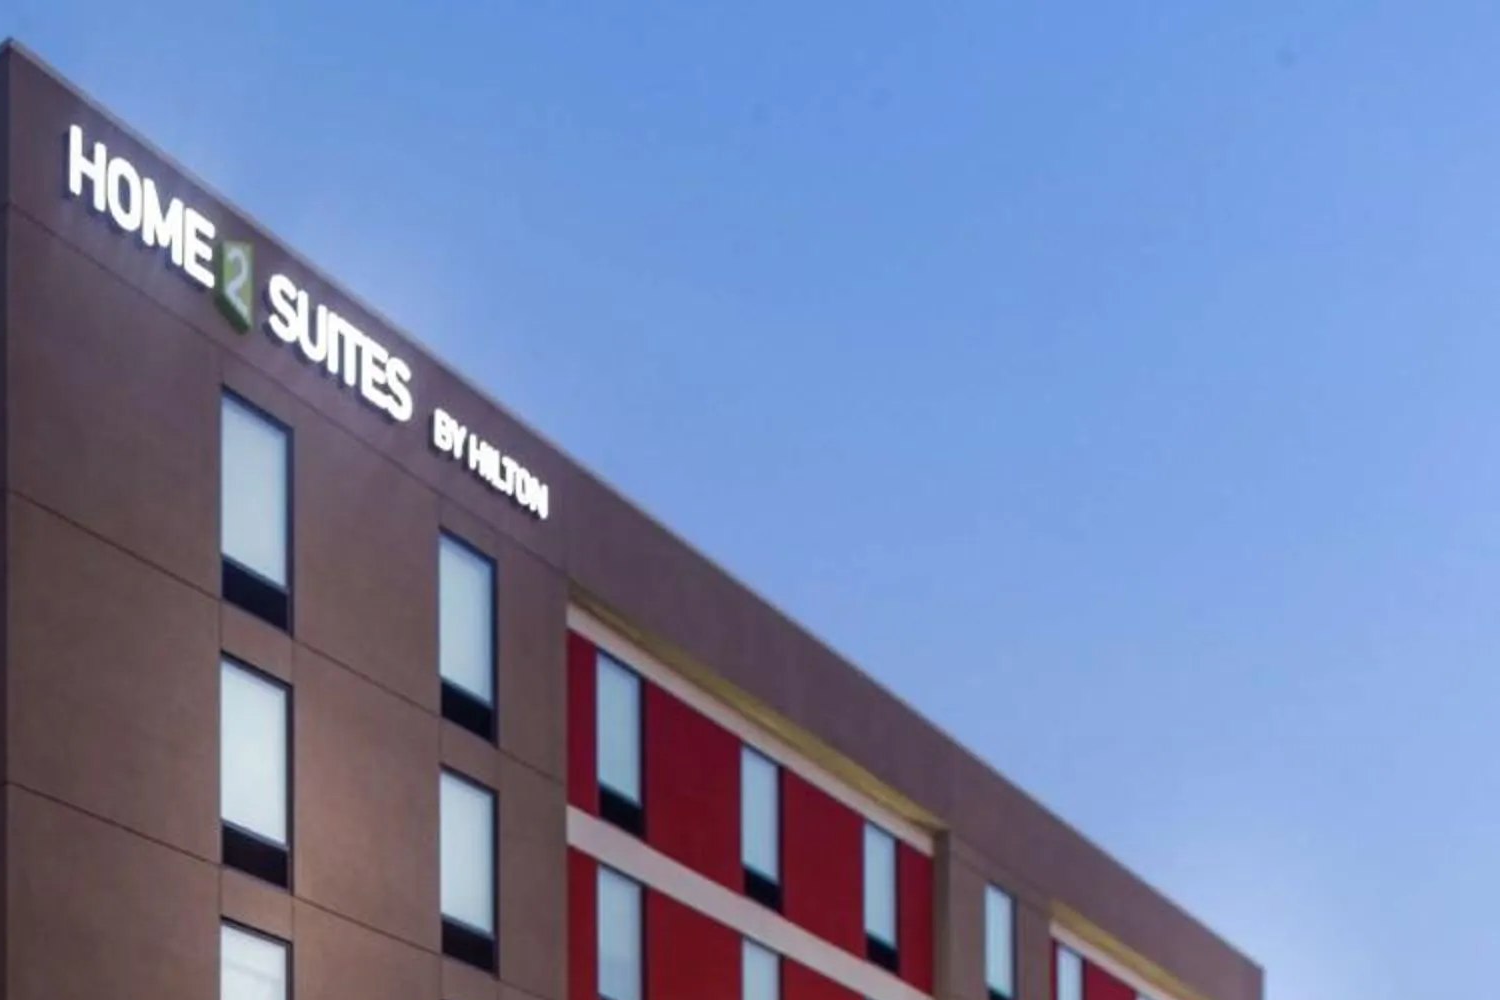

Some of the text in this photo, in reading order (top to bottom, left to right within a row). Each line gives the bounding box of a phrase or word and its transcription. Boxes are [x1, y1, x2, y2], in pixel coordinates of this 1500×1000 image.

[69, 125, 548, 519] HOME 2 SUITES BY HILTON
